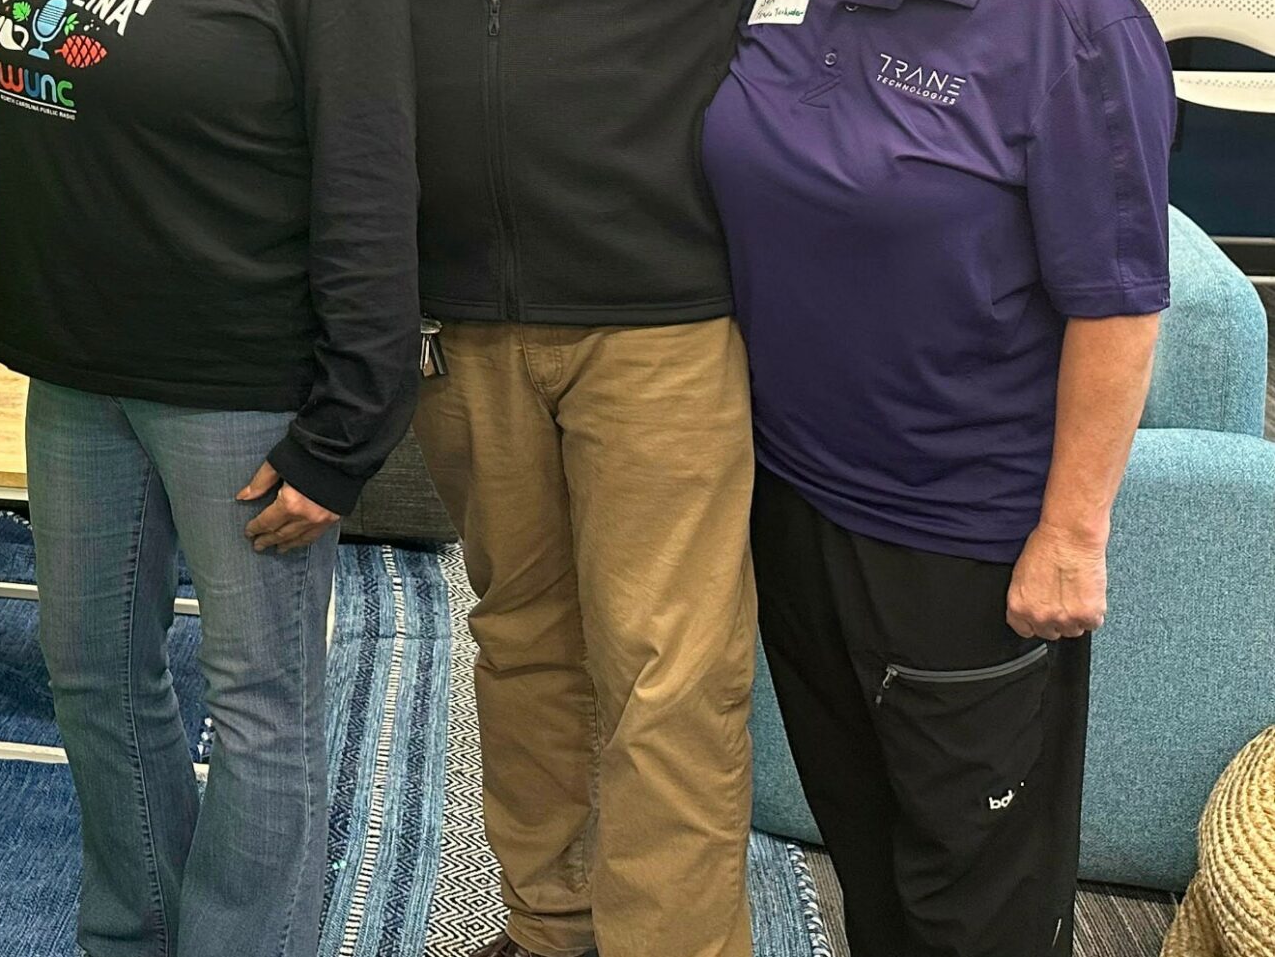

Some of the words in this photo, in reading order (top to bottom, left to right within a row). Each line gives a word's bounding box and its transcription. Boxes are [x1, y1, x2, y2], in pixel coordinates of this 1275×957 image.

[876, 74, 956, 105] TECHNOLOGIES
[880, 53, 966, 95] TRANE
[15, 100, 40, 112] CAROLINA
[40, 106, 58, 117] PUBLIC
[59, 111, 76, 121] RADIO
